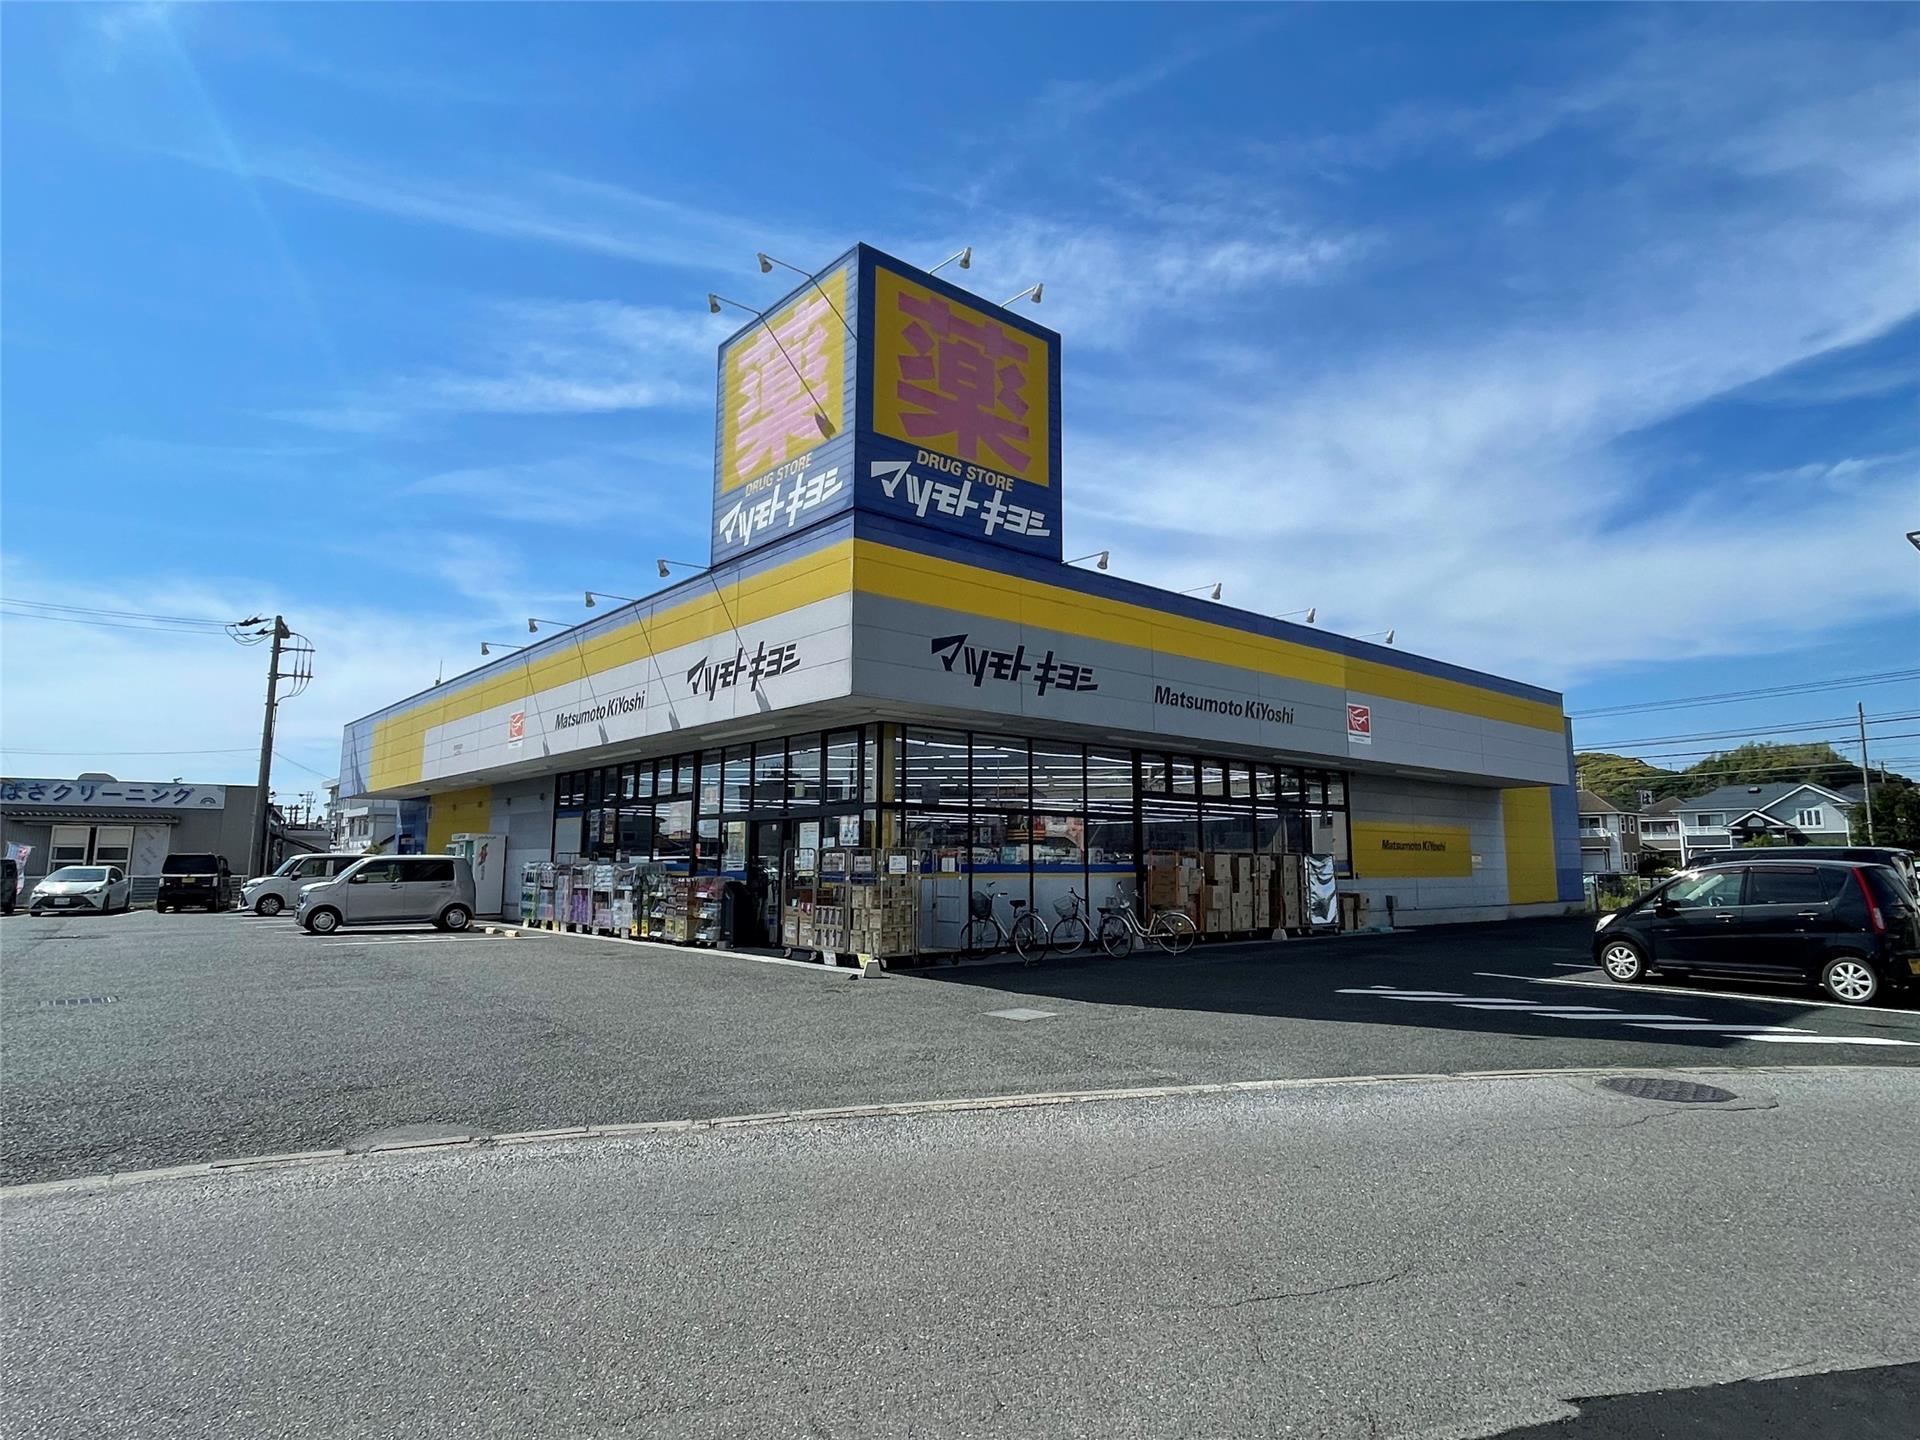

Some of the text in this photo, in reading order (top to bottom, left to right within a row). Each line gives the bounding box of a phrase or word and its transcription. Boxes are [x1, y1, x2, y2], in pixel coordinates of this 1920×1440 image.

[735, 291, 831, 479] 薬
[898, 290, 1032, 474] 薬
[745, 451, 813, 497] DRUG STORE
[916, 449, 1015, 493] DRUG STORE
[555, 689, 646, 731] Matsumoto KiYoshi
[1154, 684, 1295, 725] Matsumoto KiYoshi
[1381, 839, 1422, 852] Matsumoto
